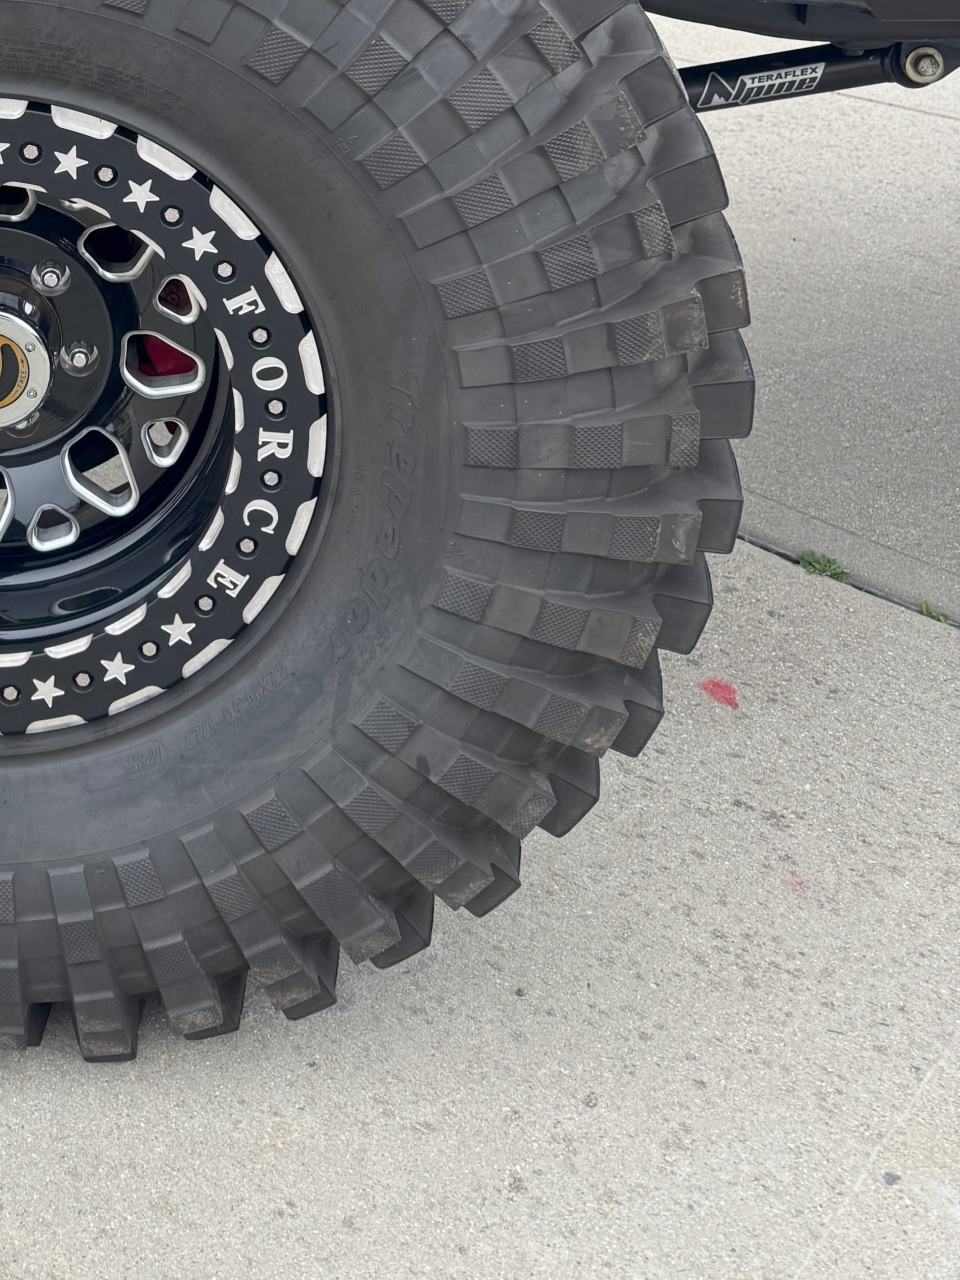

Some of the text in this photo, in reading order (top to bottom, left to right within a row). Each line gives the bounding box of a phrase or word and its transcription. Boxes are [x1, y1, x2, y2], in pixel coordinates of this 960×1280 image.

[749, 65, 819, 85] TERAFLEX
[17, 370, 27, 389] FREE
[206, 286, 293, 600] FORCE
[330, 369, 422, 664] Trepador
[183, 662, 288, 752] 42X14.50-17LT
[127, 745, 163, 773] M+S
